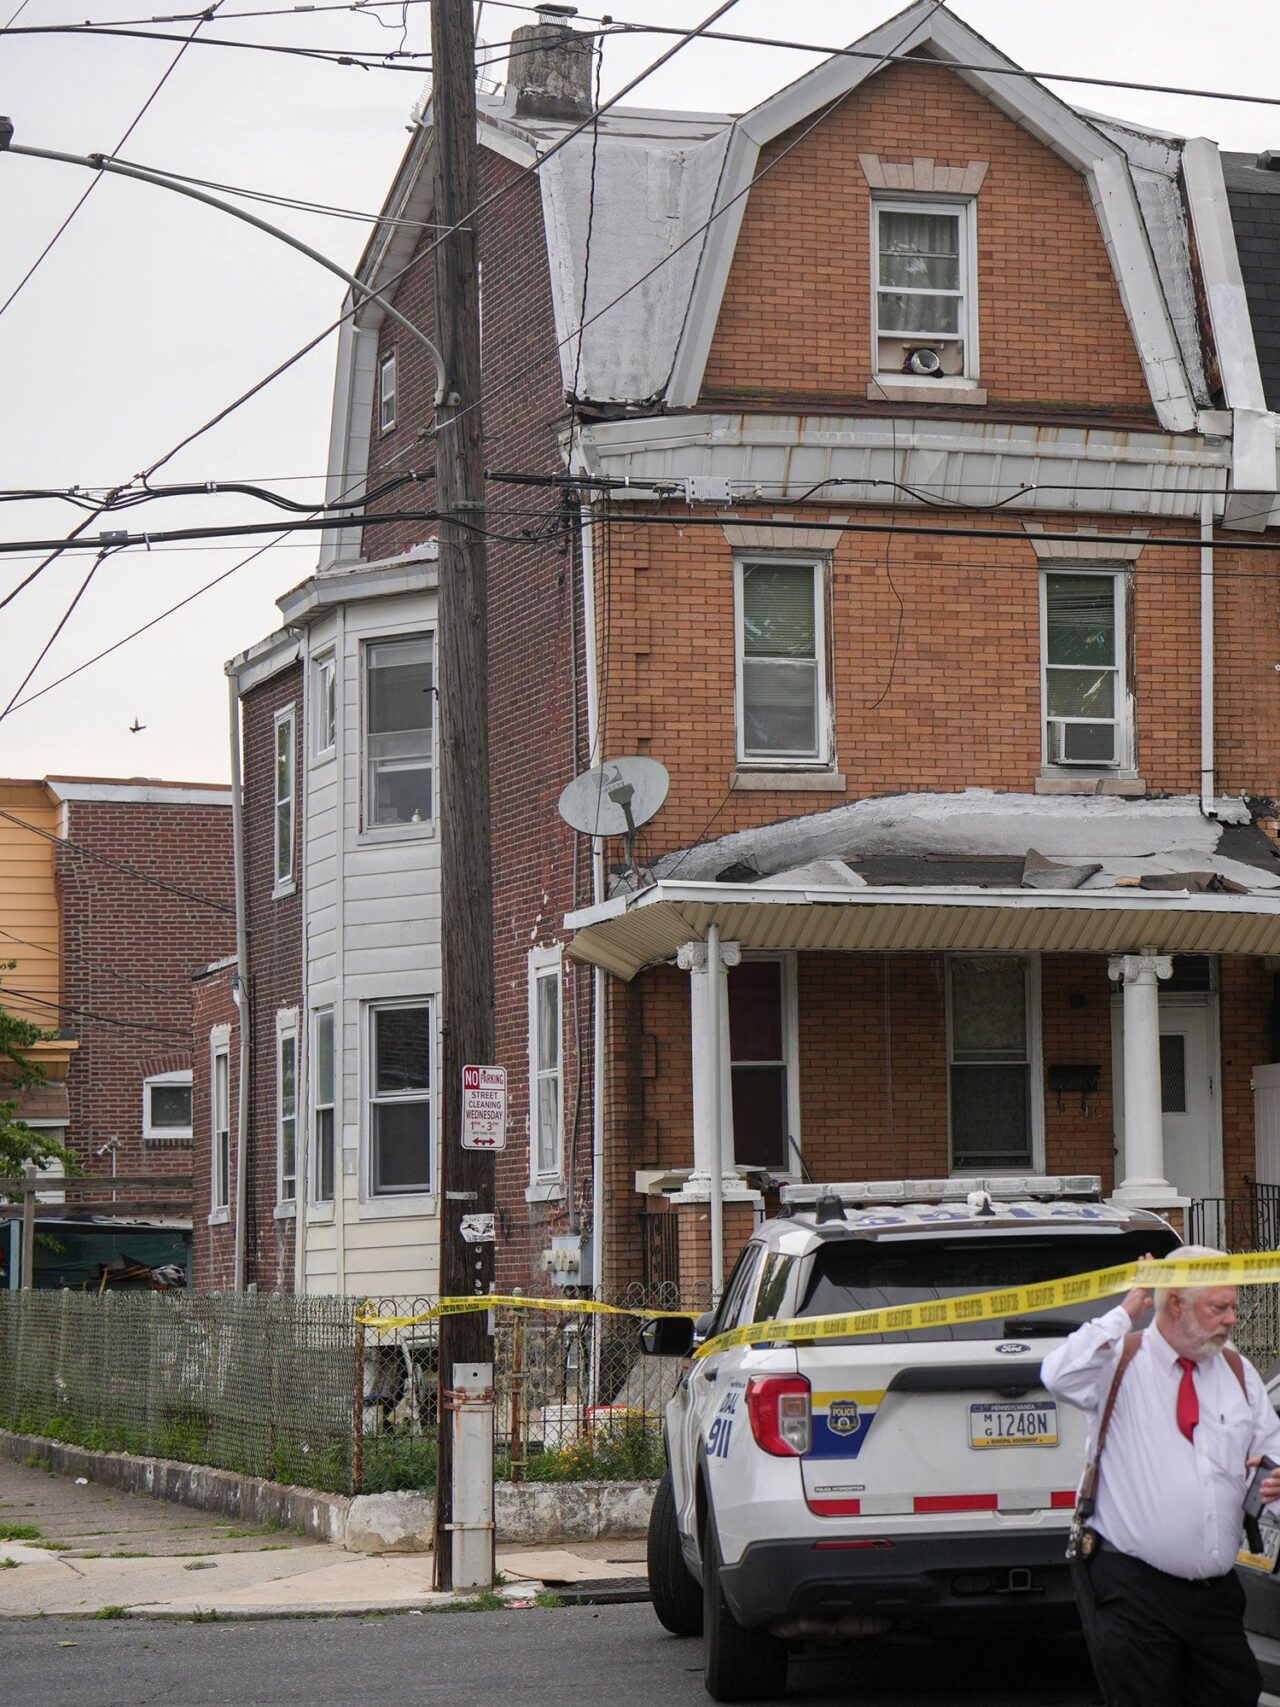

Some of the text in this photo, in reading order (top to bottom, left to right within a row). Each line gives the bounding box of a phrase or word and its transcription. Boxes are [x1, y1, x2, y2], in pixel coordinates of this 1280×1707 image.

[465, 1070, 503, 1086] NO PARKING
[471, 1091, 498, 1100] STREET
[468, 1100, 502, 1109] CLEANING
[465, 1110, 503, 1120] WEDNESDAY
[719, 1392, 740, 1415] DIAL
[990, 1403, 1036, 1412] PENNSYLVANIA
[832, 1408, 855, 1416] POLICE
[997, 1412, 1048, 1437] 1248N
[705, 1418, 733, 1459] 911
